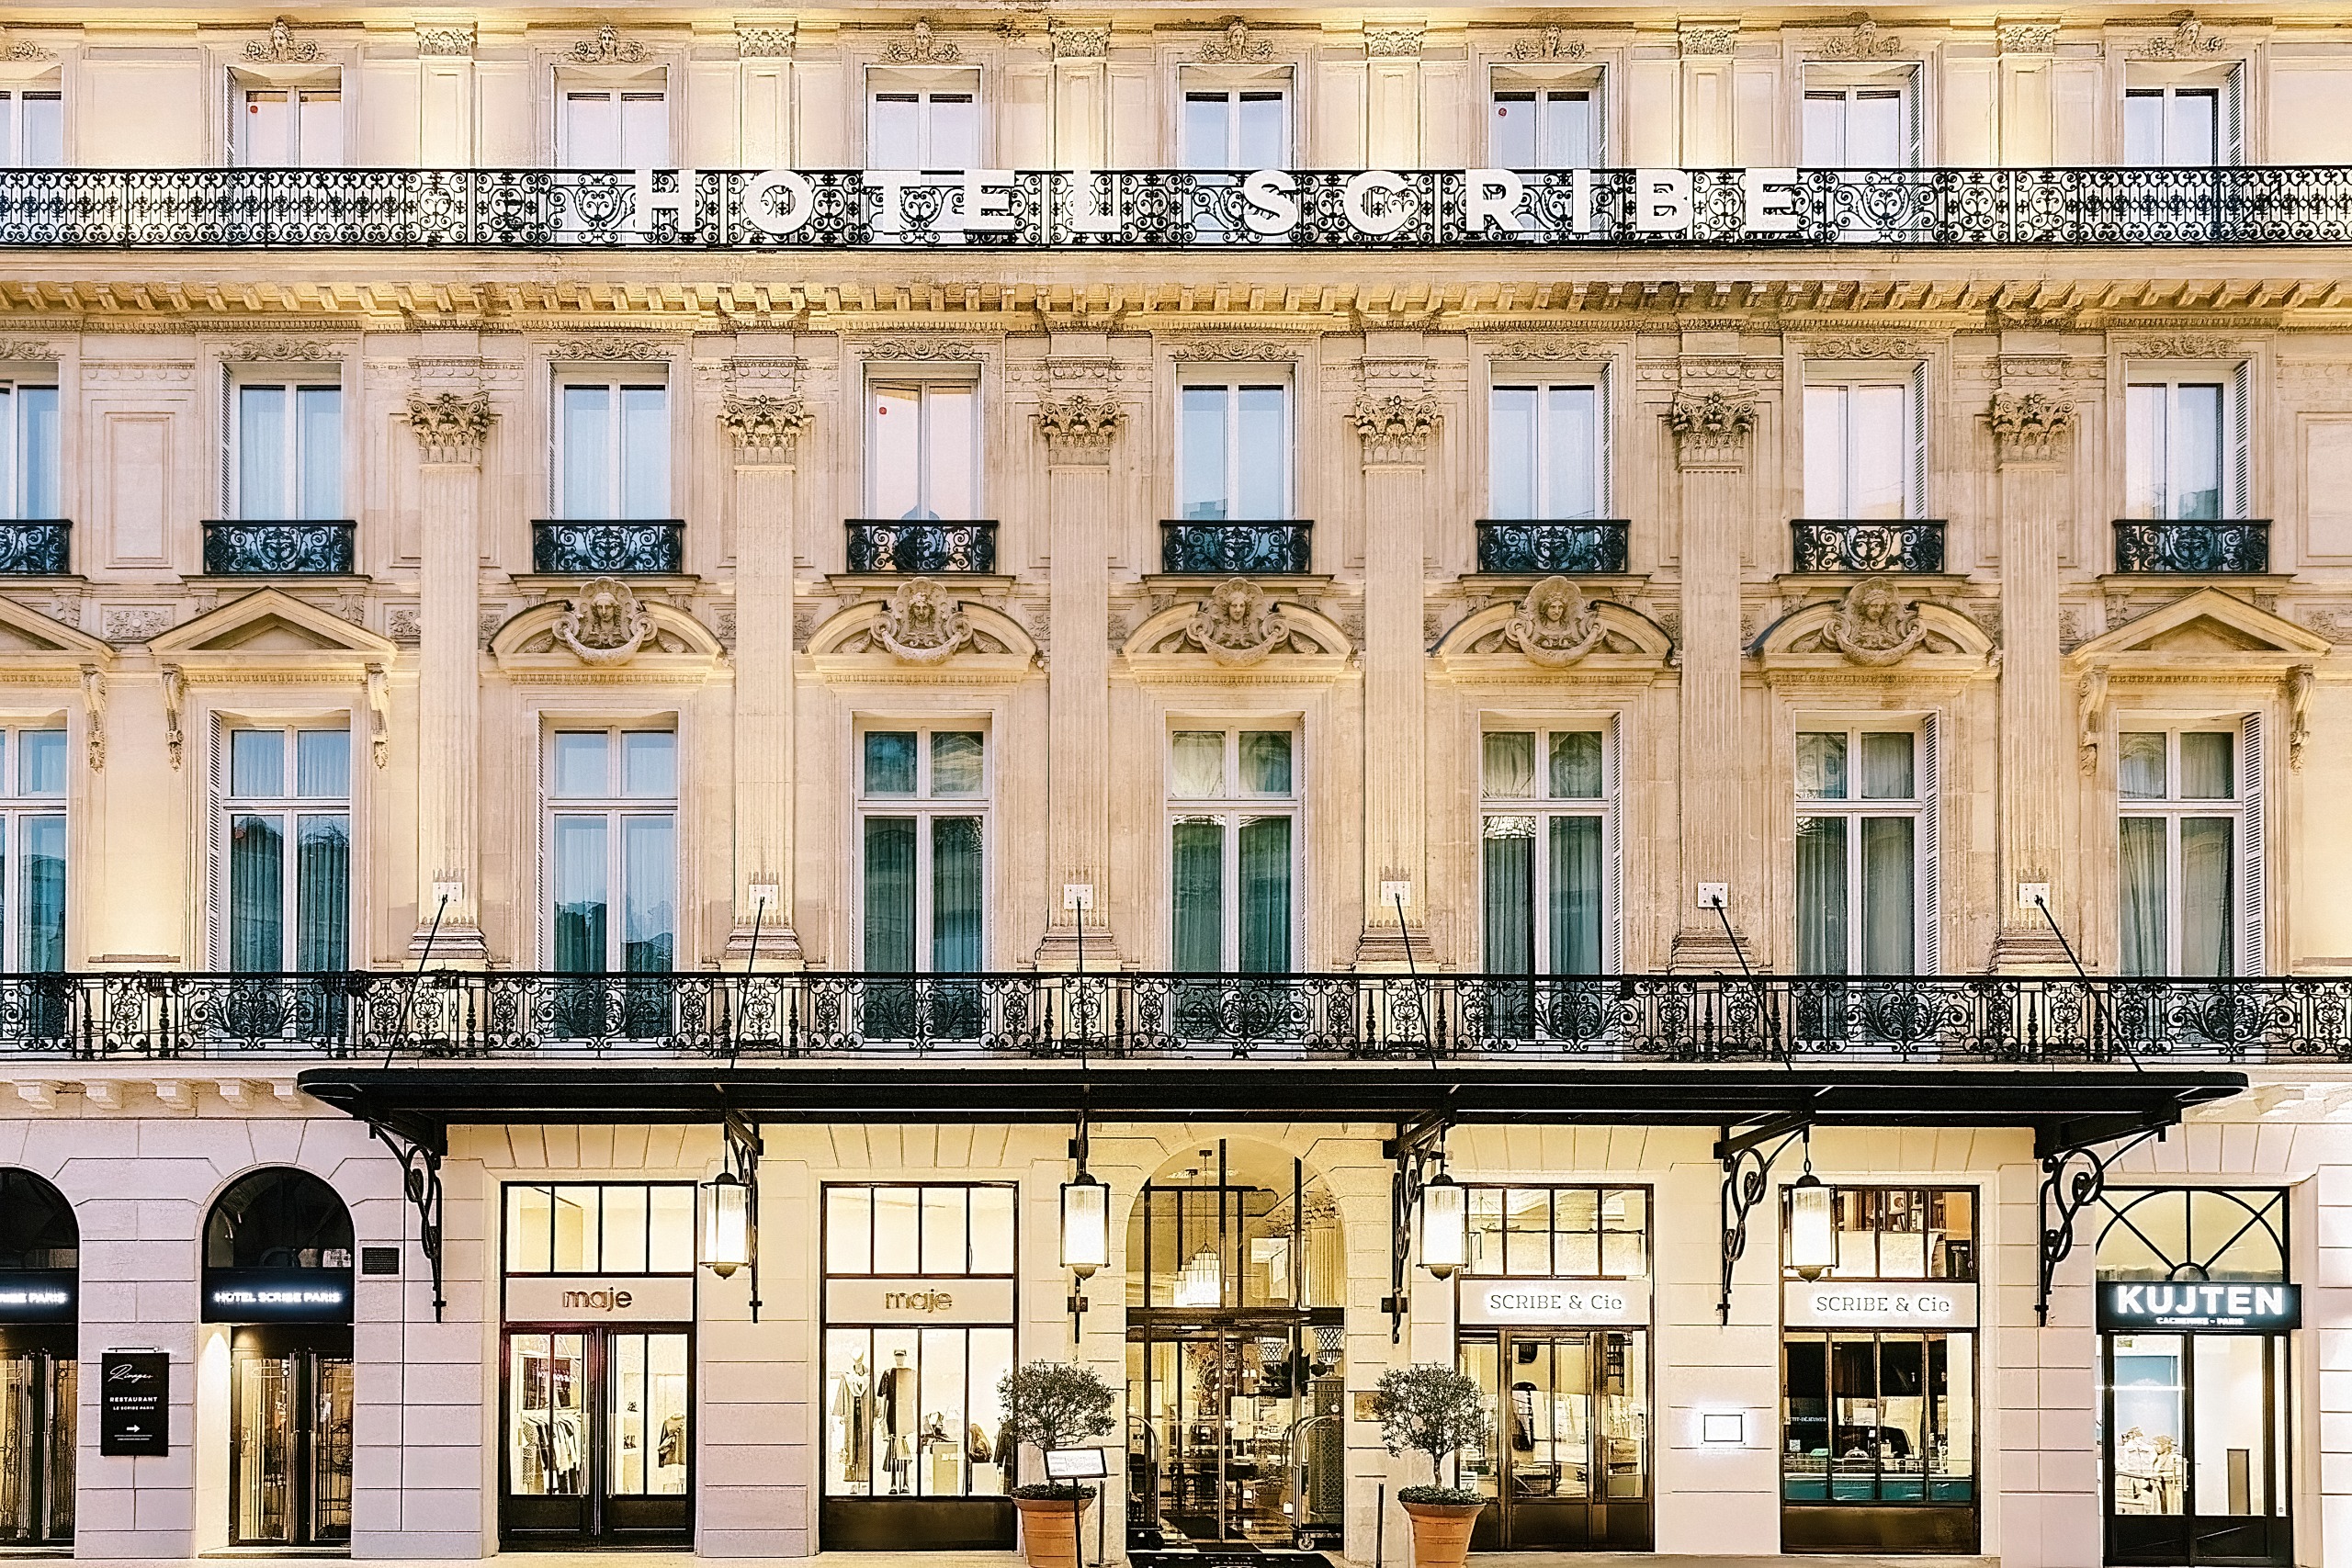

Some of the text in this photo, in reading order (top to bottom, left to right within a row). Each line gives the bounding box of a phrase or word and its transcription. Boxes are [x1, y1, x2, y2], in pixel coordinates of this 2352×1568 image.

[635, 167, 1799, 237] HOTEL SCRIBE
[28, 1292, 67, 1303] PARIS
[214, 1292, 341, 1303] HOTEL SCRIBE PARIS
[562, 1286, 633, 1312] maje
[885, 1288, 953, 1313] maje
[1490, 1294, 1623, 1310] SCRIBE & Cie
[1816, 1296, 1950, 1312] SCRIBE & Cie
[2117, 1285, 2284, 1315] KUJTEN
